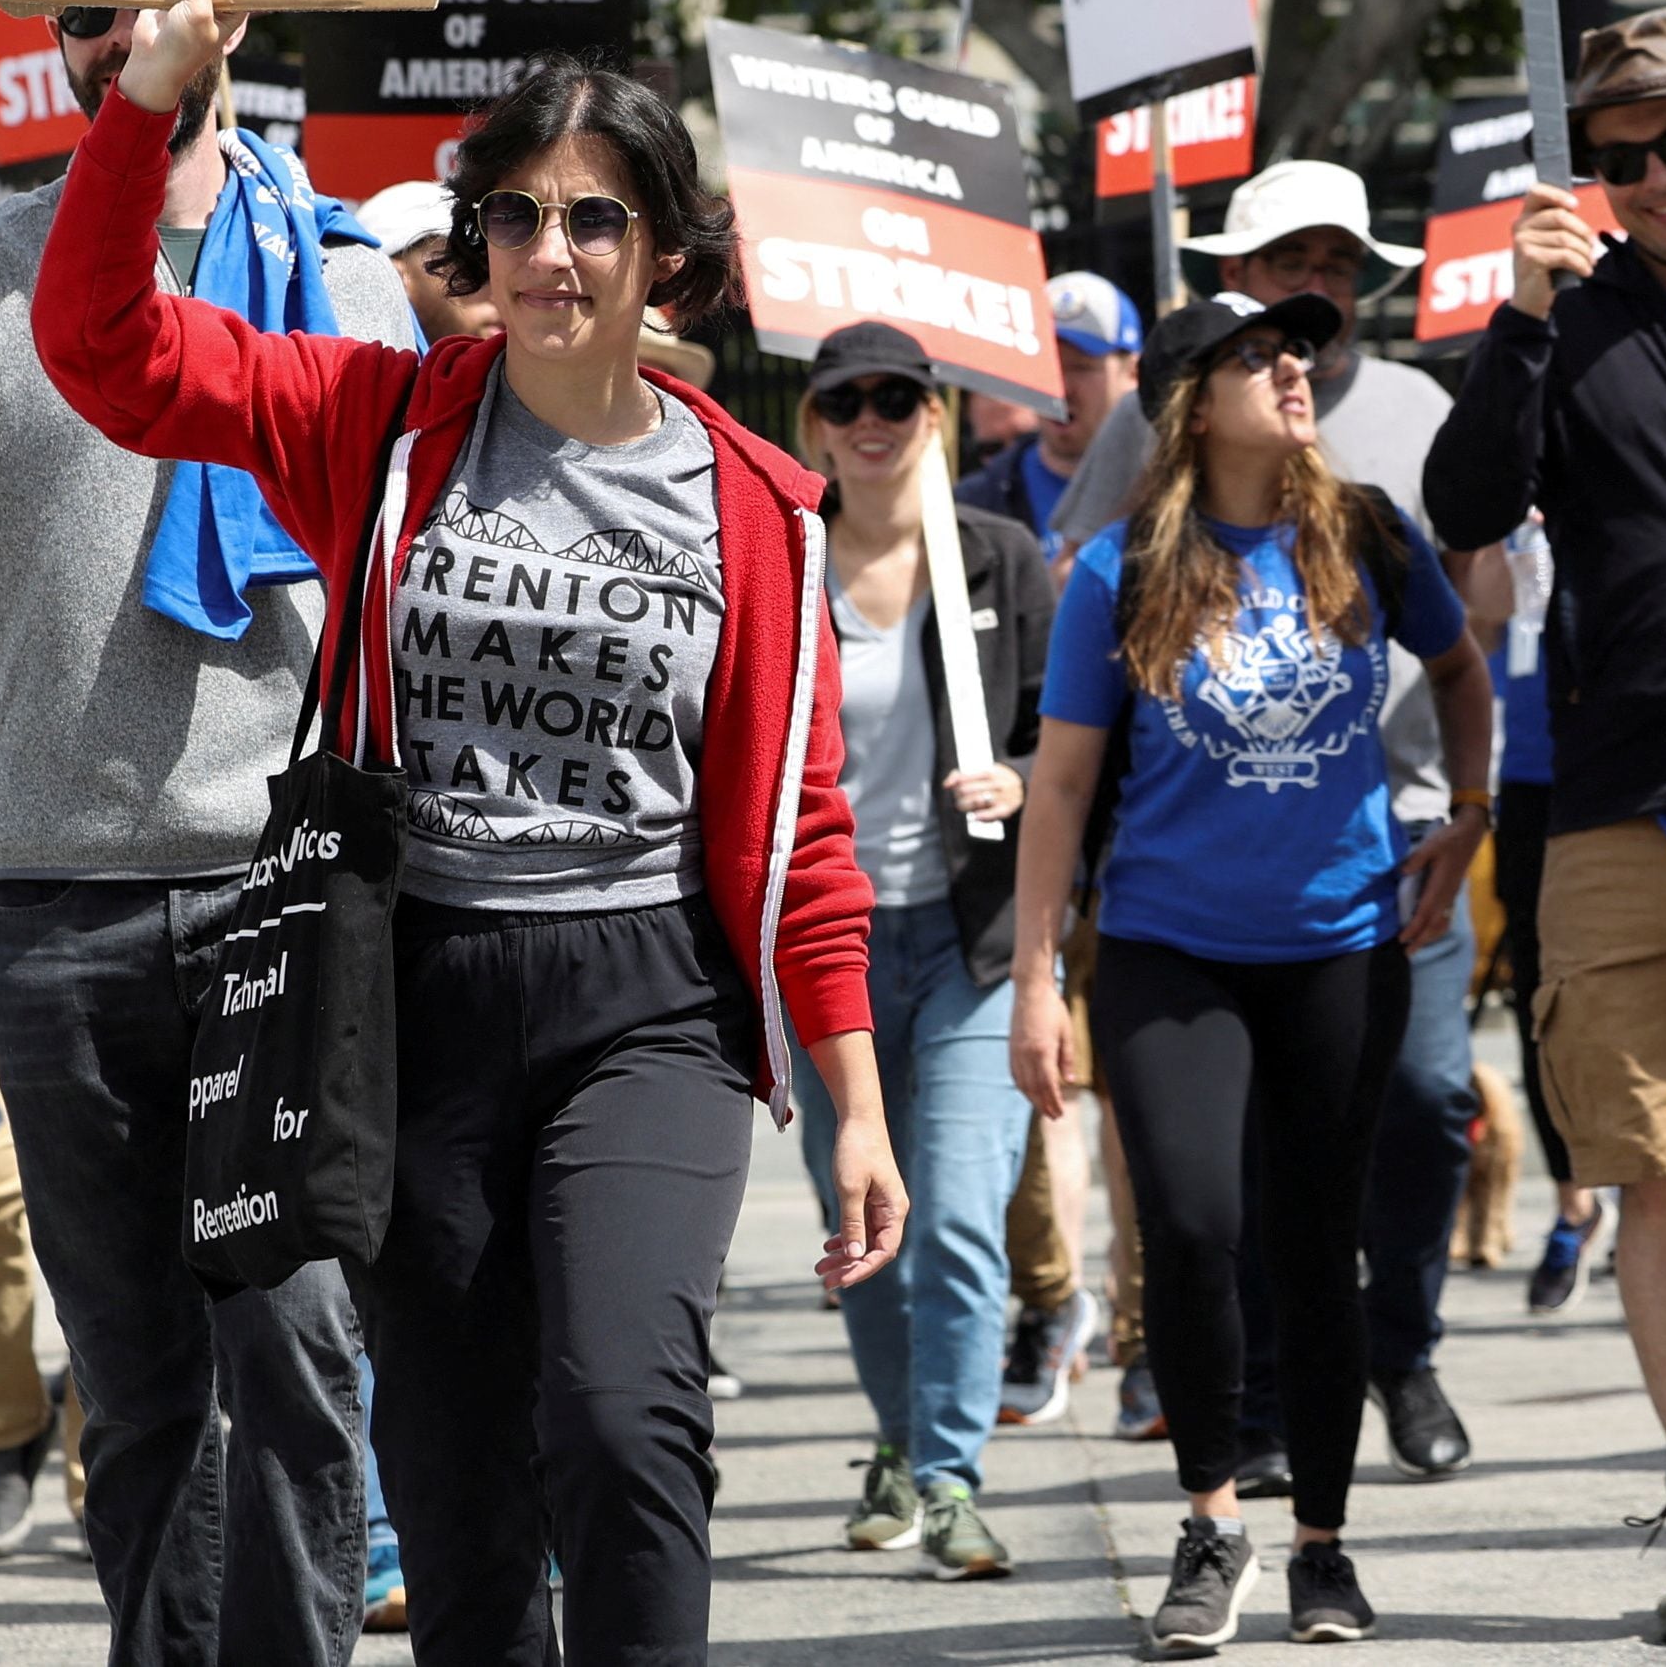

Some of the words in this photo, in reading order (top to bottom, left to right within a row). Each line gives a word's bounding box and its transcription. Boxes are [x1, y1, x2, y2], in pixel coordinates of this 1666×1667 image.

[444, 14, 487, 49] OF
[730, 53, 896, 114] WRITERS
[896, 86, 1002, 139] GUILD
[800, 135, 965, 201] AMERICA
[859, 206, 931, 256] ON
[757, 236, 1041, 357] STRIKE!
[399, 543, 697, 636] TRENTON
[401, 607, 674, 693] MAKES
[481, 680, 676, 753] WORLD
[410, 739, 632, 815] TAKES
[189, 1054, 245, 1121] pparel
[273, 1097, 309, 1142] for
[193, 1183, 279, 1243] Recreation
